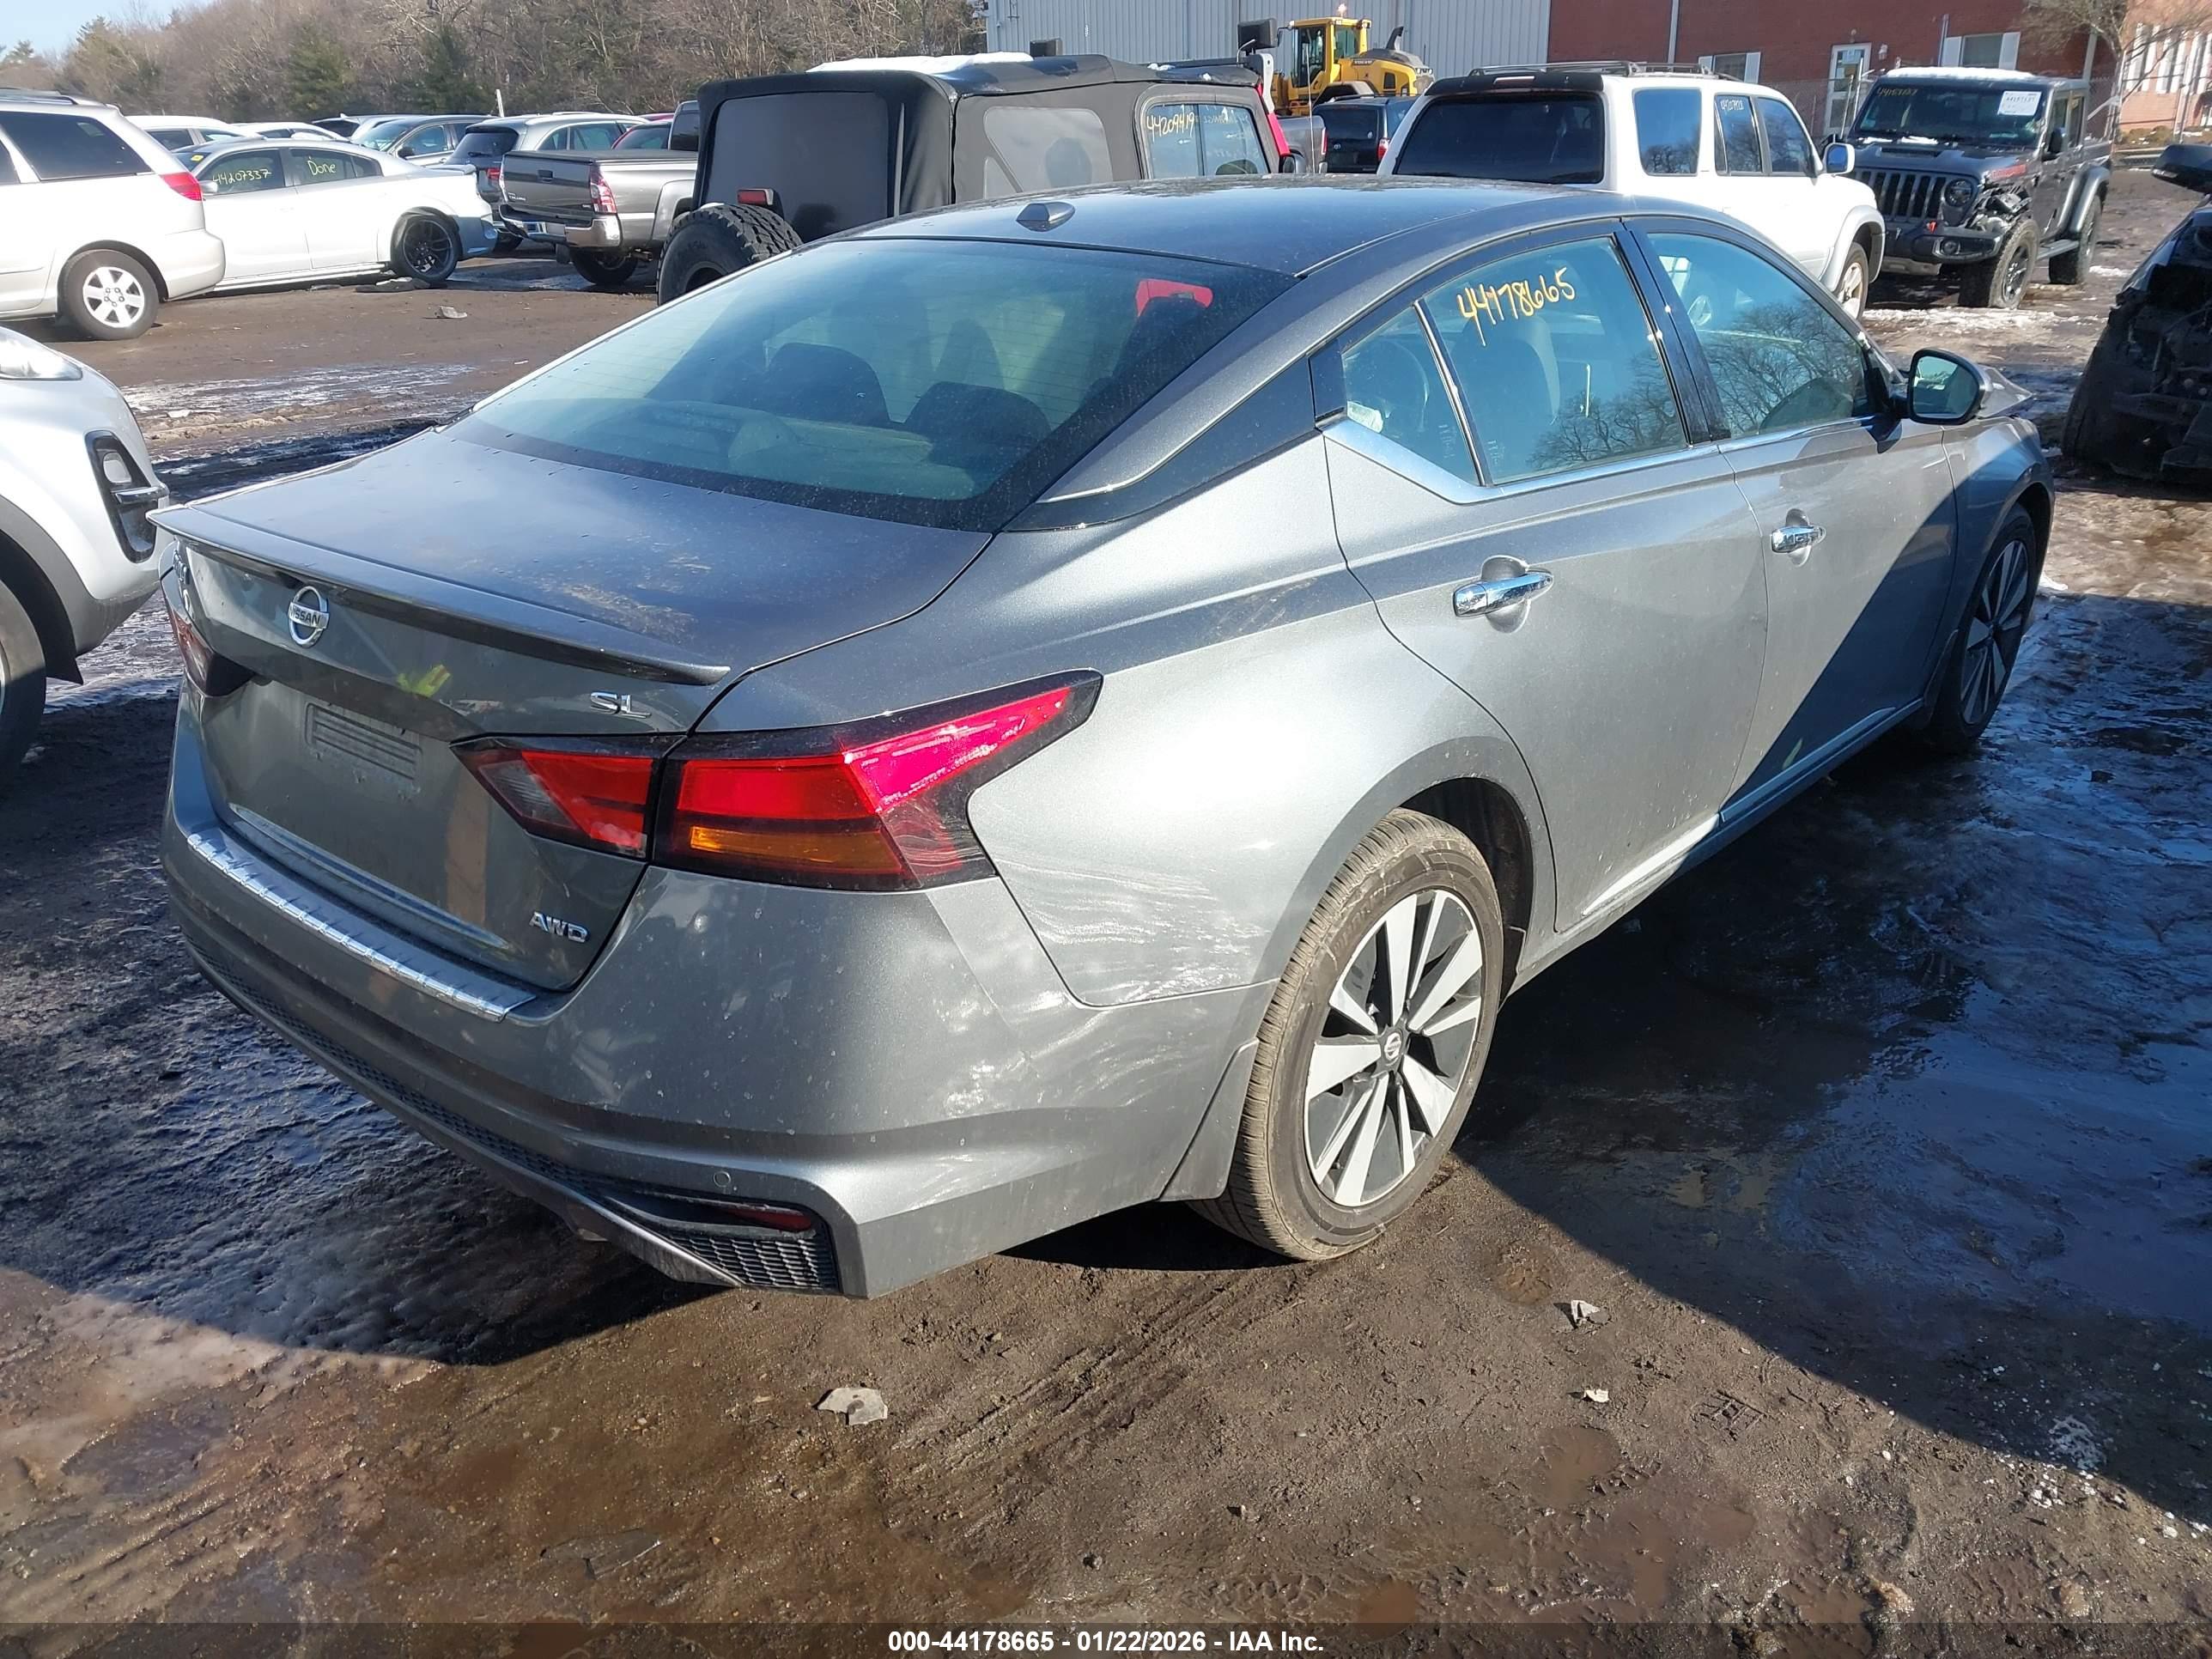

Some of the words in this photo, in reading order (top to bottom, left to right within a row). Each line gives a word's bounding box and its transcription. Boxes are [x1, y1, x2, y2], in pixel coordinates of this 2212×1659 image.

[212, 168, 272, 185] 44207337
[307, 156, 336, 176] Done
[1457, 266, 1576, 346] 44178665
[289, 605, 321, 626] NISSAN
[590, 691, 651, 716] SL
[529, 910, 589, 943] AWD
